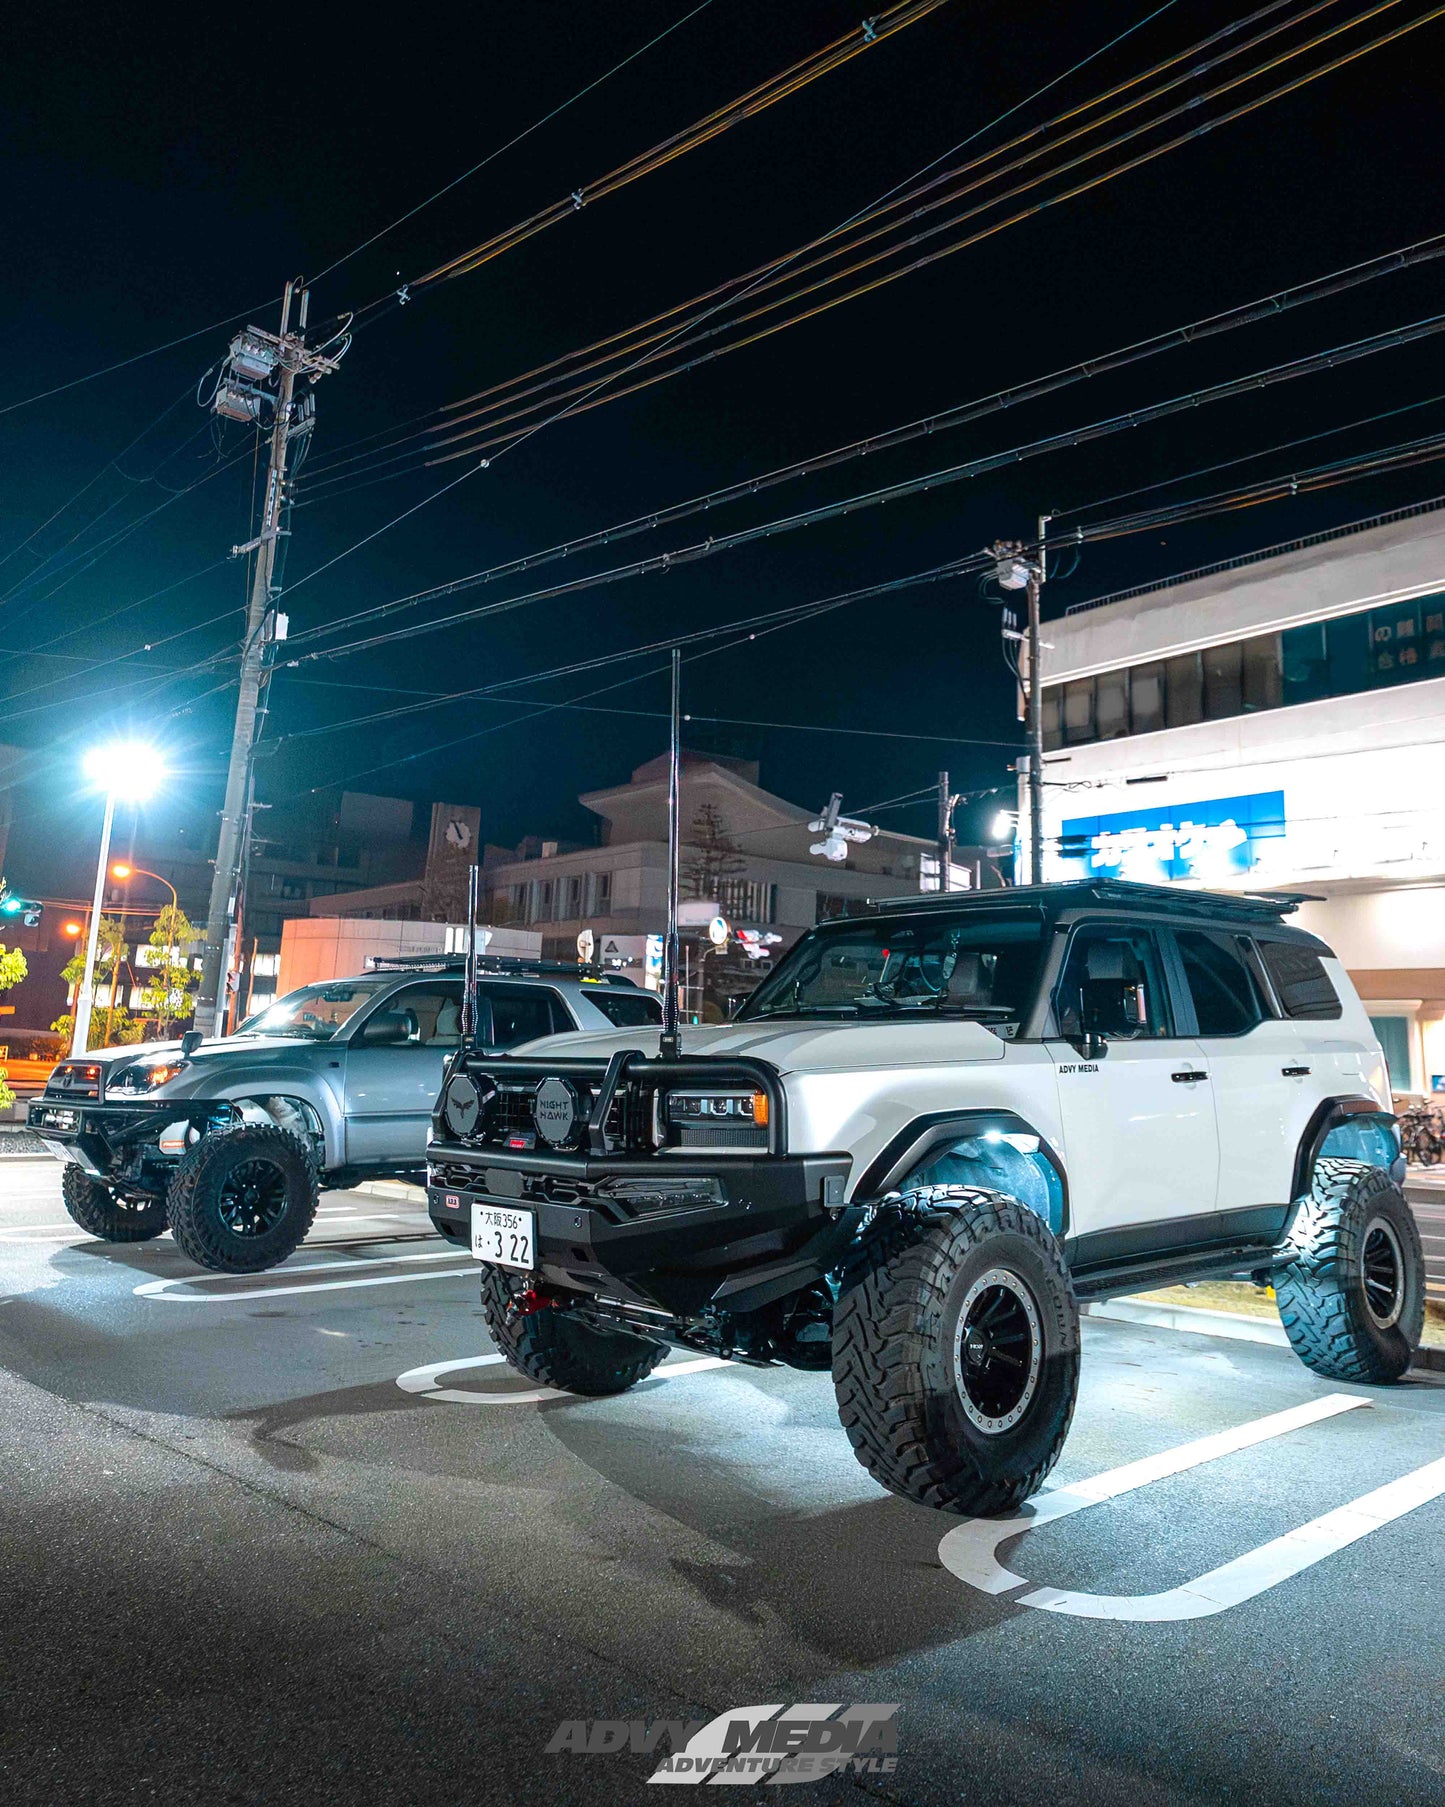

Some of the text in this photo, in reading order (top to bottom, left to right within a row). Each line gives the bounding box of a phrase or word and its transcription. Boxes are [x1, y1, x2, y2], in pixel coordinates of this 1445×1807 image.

[1058, 1063, 1099, 1075] ADVY MEDIA
[539, 1099, 569, 1110] NIGHT
[539, 1110, 569, 1121] HAWK
